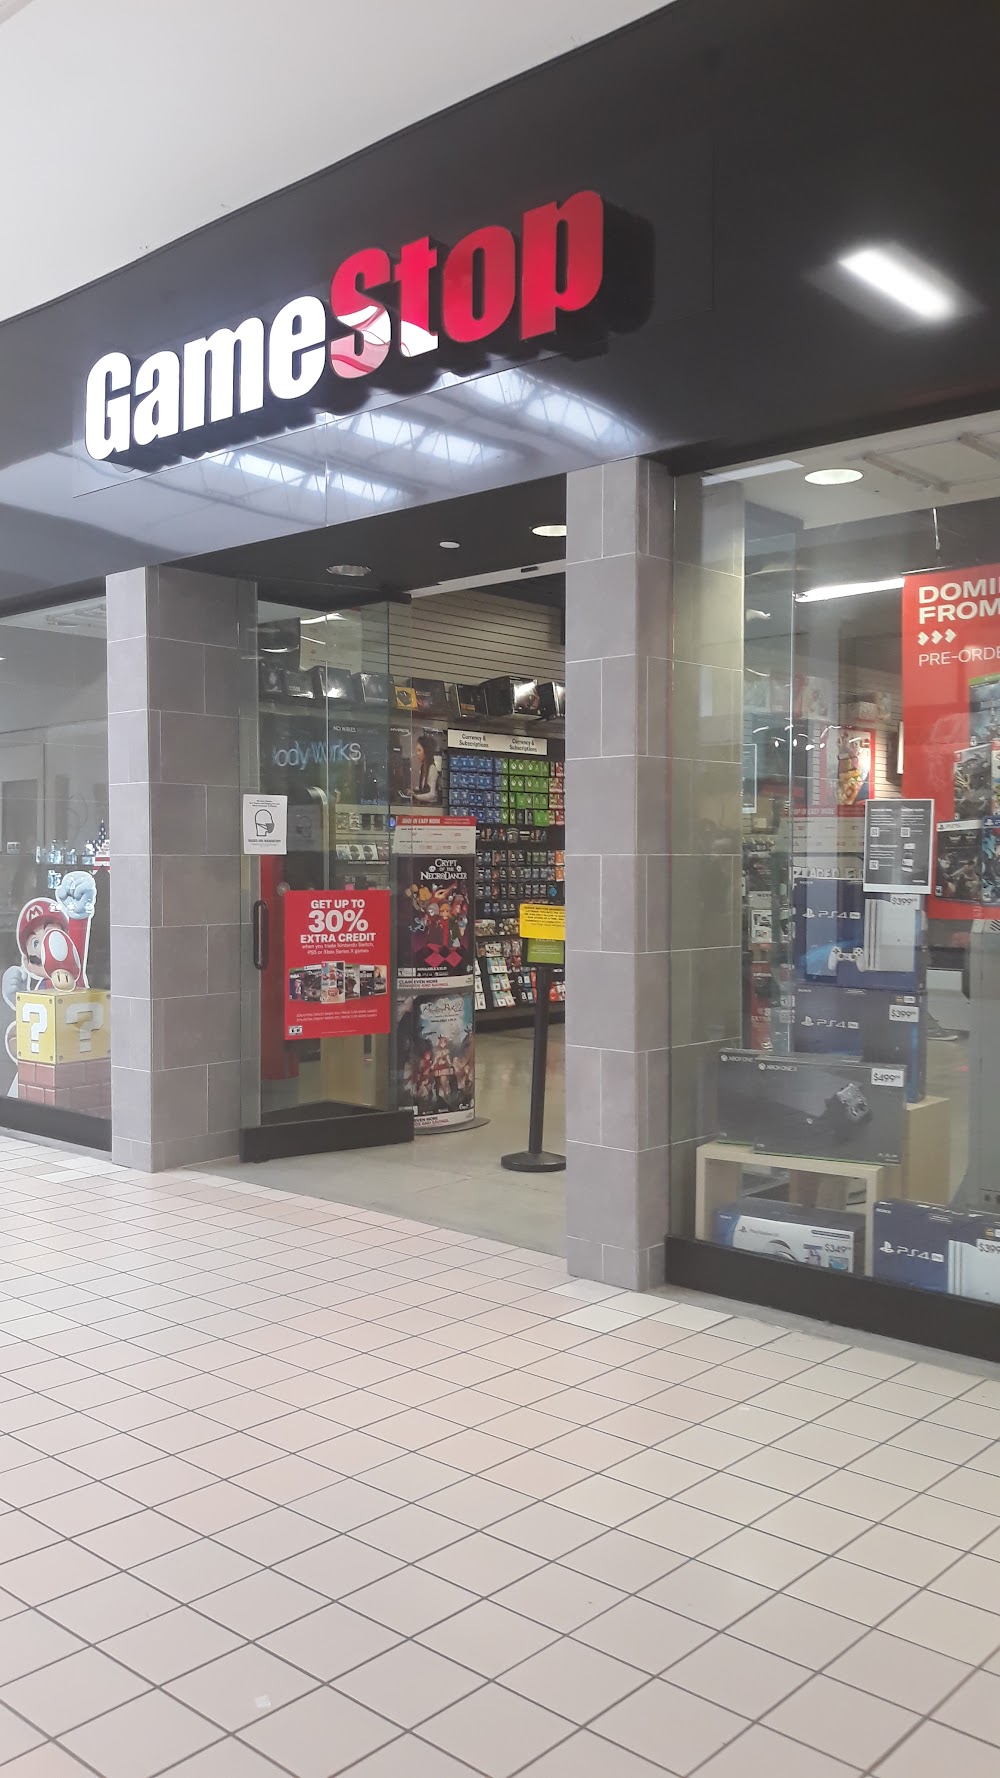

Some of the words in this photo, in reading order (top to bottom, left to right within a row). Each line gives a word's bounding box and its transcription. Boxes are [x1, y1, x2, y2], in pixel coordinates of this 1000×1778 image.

[85, 189, 604, 461] GameStop
[918, 577, 1000, 604] DOMI
[919, 598, 1000, 624] FROM
[462, 733, 482, 743] Currency
[512, 738, 531, 747] Currency
[459, 740, 489, 749] Subscriptions
[509, 745, 538, 753] Subscriptions
[435, 858, 458, 867] CRYPT
[310, 899, 332, 909] GET
[334, 899, 350, 909] UP
[351, 899, 366, 908] TO
[818, 911, 849, 919] PS4
[308, 909, 369, 933] 30%
[300, 934, 336, 943] EXTRA
[338, 933, 376, 942] CREDIT
[817, 1018, 847, 1028] PS4
[897, 1245, 931, 1260] PS4
